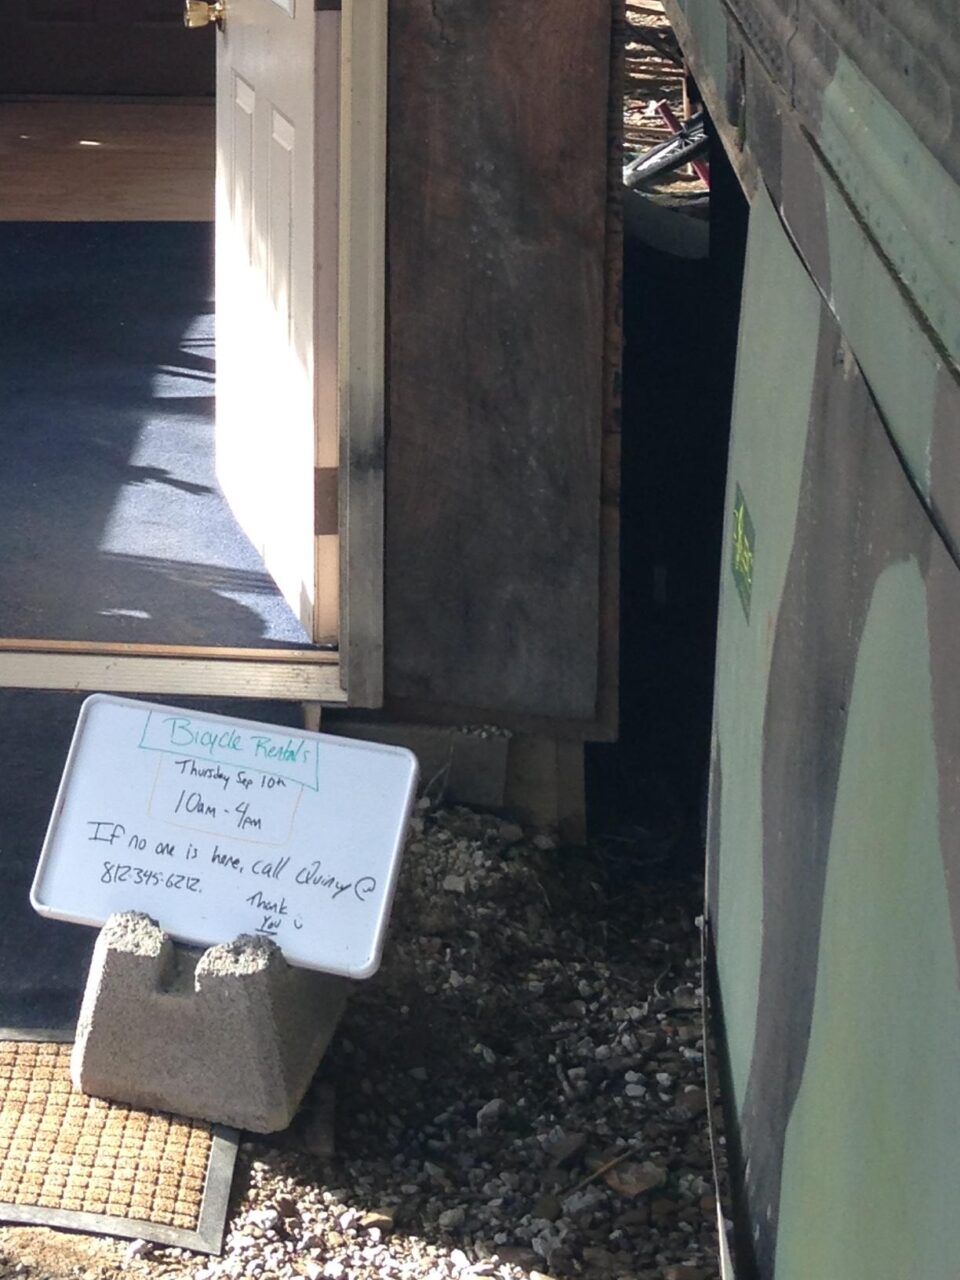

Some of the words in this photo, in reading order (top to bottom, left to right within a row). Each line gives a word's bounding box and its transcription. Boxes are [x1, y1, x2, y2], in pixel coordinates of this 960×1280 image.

[162, 716, 244, 755] Bicycle
[250, 734, 311, 764] Rentals
[175, 759, 231, 790] Thursday
[236, 771, 254, 789] Sep
[87, 821, 126, 845] If
[128, 834, 147, 851] no
[155, 842, 176, 858] one
[186, 843, 199, 860] is
[211, 845, 244, 874] here,
[251, 856, 292, 880] call
[354, 876, 378, 903] @
[246, 891, 289, 915] Thank
[260, 915, 283, 932] You
